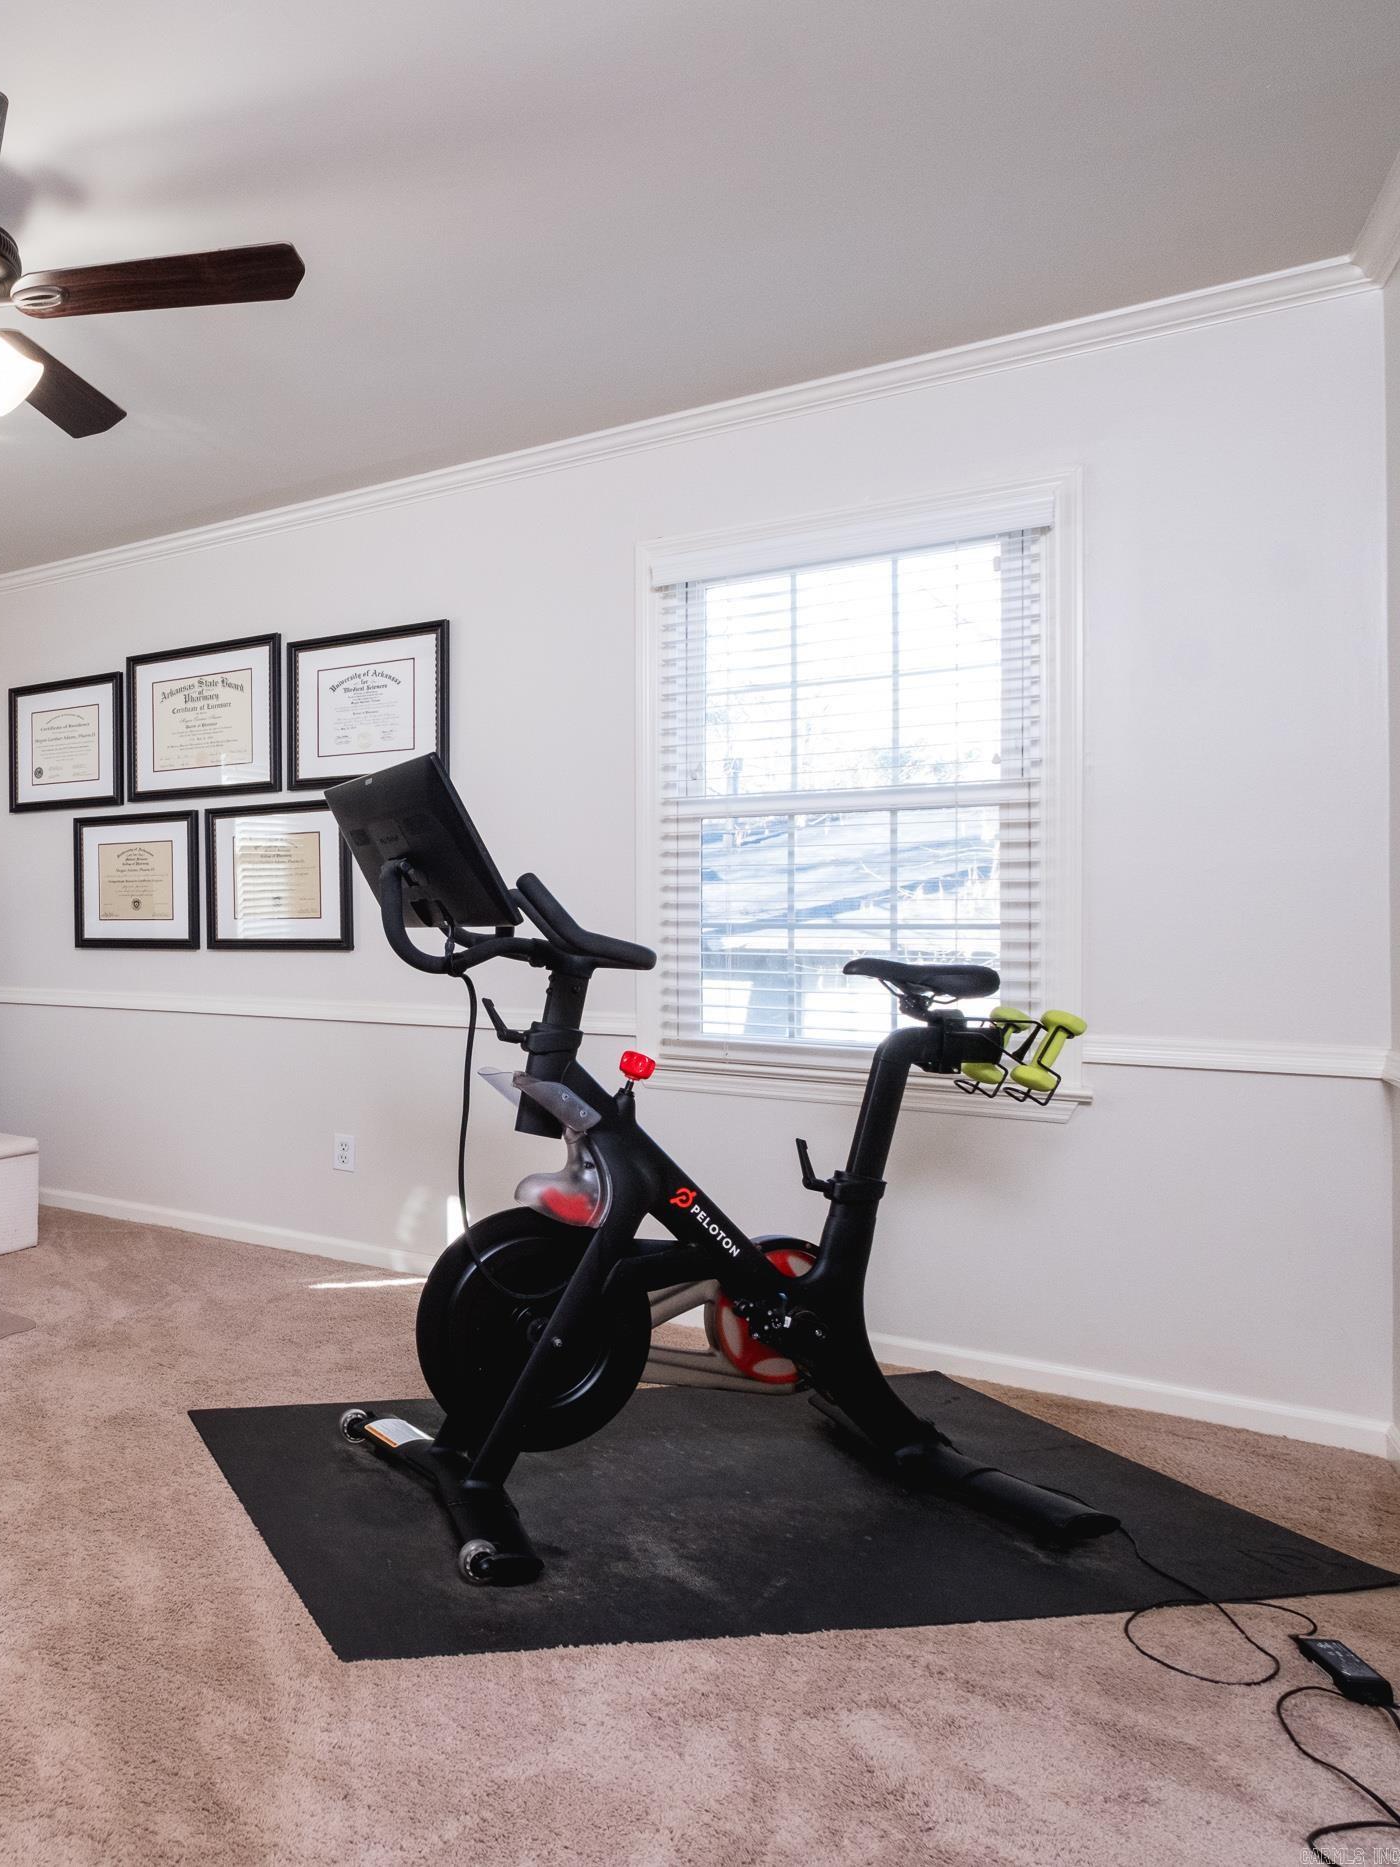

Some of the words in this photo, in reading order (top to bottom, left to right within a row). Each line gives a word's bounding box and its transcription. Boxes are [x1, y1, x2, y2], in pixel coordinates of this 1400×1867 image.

[160, 683, 195, 703] Arkansas
[198, 678, 219, 688] State
[221, 676, 245, 692] Board
[329, 672, 361, 692] University
[371, 670, 401, 685] Arkansas
[183, 693, 219, 704] Pharmacy
[690, 1204, 740, 1257] PELOTON
